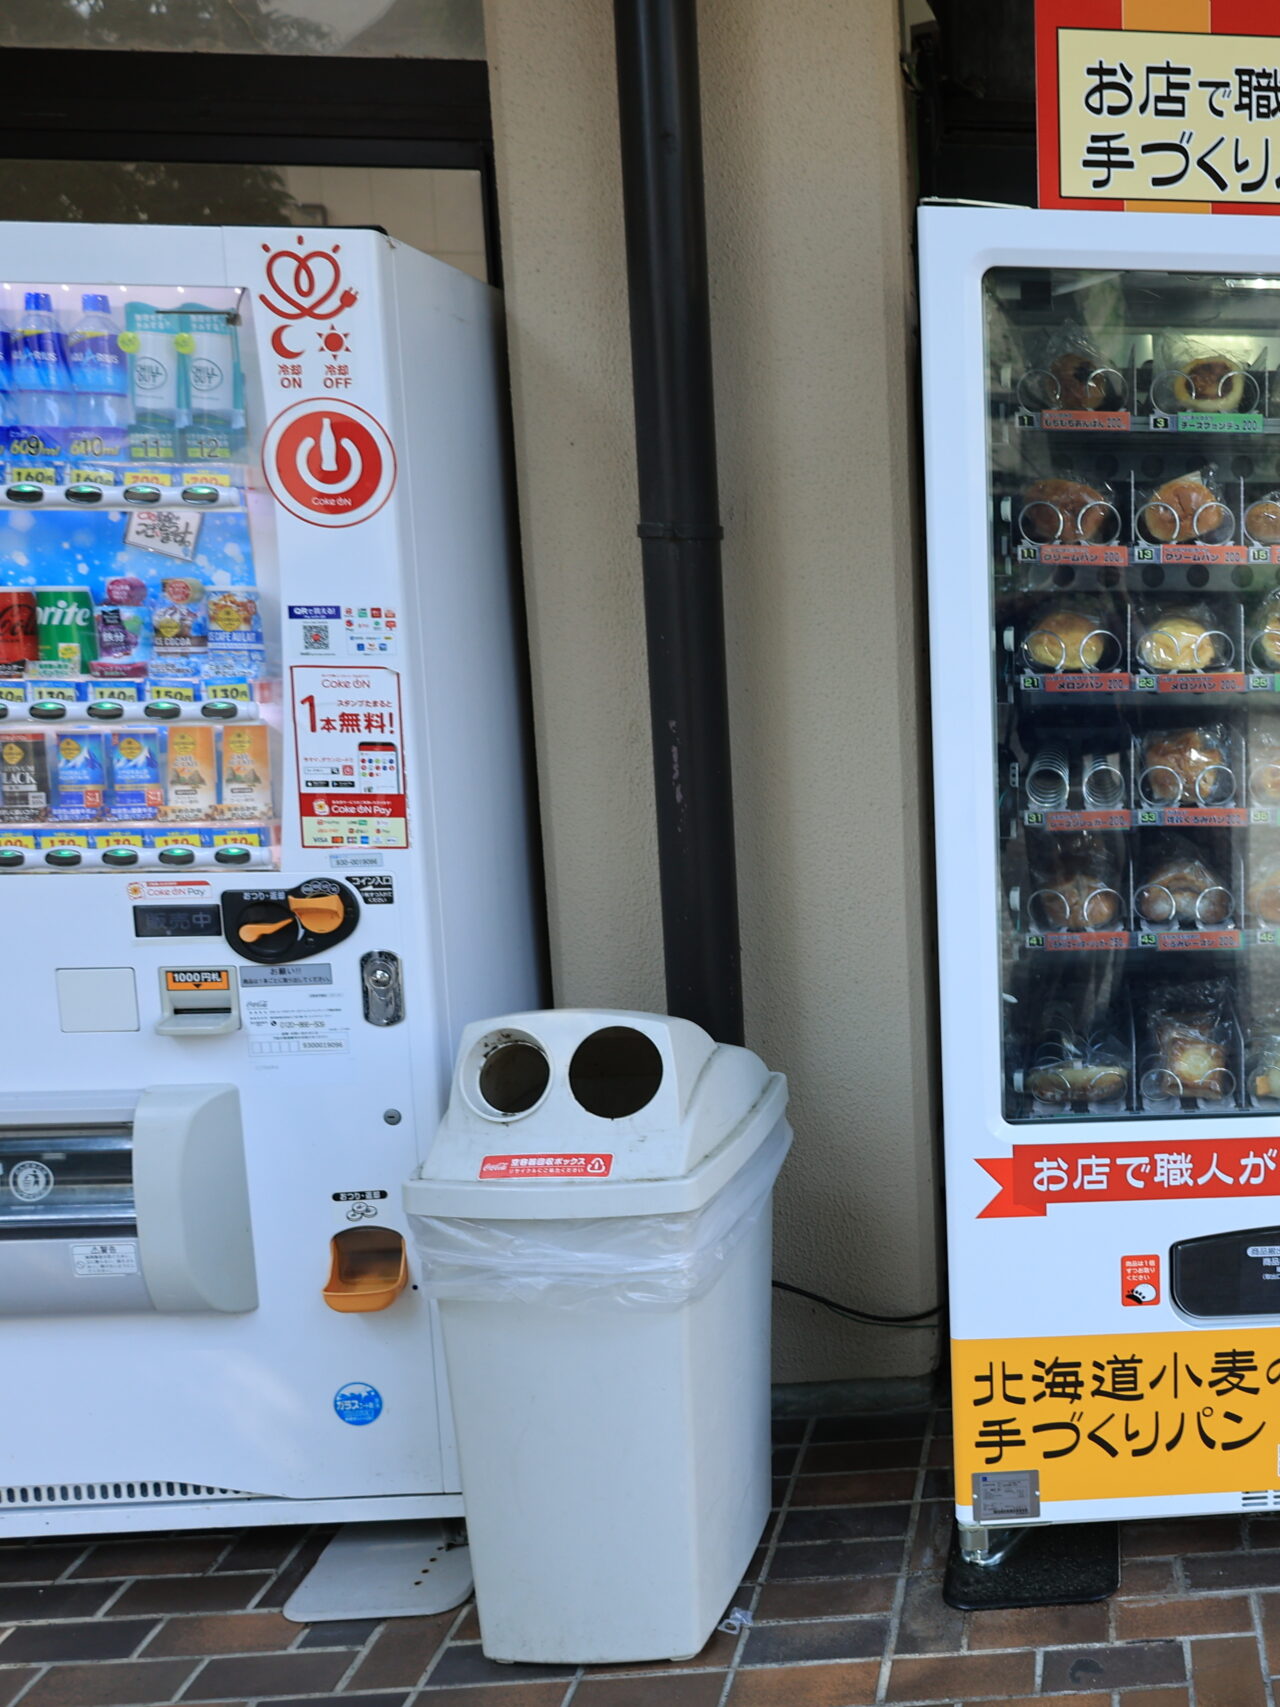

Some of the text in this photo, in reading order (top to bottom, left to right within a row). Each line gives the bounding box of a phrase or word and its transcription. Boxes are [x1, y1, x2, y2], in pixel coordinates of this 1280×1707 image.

[278, 364, 350, 376] 冷却 冷却
[280, 377, 352, 390] ON OFF
[321, 679, 351, 689] Coke
[1057, 682, 1103, 690] メロンパン
[1170, 682, 1216, 690] メロンパン
[331, 805, 356, 814] Coke
[374, 804, 392, 816] Pay
[352, 876, 393, 886] コイン入口
[147, 888, 170, 897] Coke
[187, 886, 206, 898] Pay
[173, 972, 222, 984] 1000円札
[974, 1407, 1267, 1465] 手づくりパン
